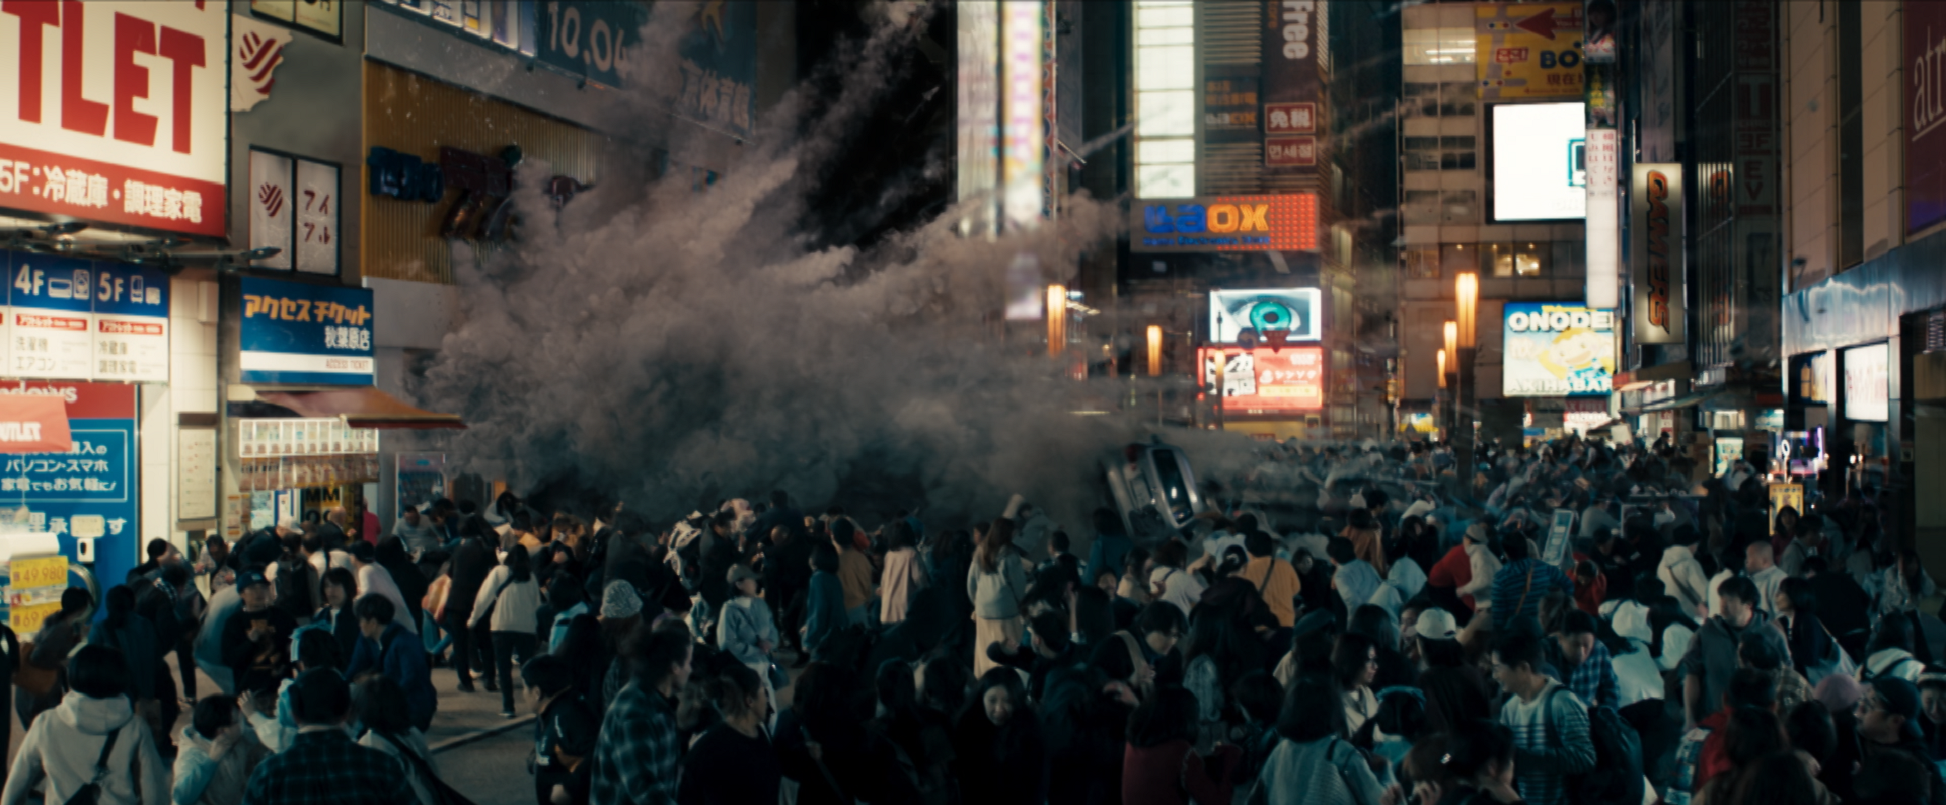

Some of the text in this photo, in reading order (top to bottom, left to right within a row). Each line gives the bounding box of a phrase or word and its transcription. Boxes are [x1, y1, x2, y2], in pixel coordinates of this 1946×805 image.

[1546, 73, 1584, 86] 現在
[1269, 108, 1311, 128] 免税
[1647, 171, 1670, 335] GAMERS
[14, 264, 44, 296] 4F
[98, 272, 125, 302] 5F
[1508, 311, 1615, 333] ONODE
[324, 326, 370, 351] 秋葉原店
[16, 356, 56, 371] エアコン
